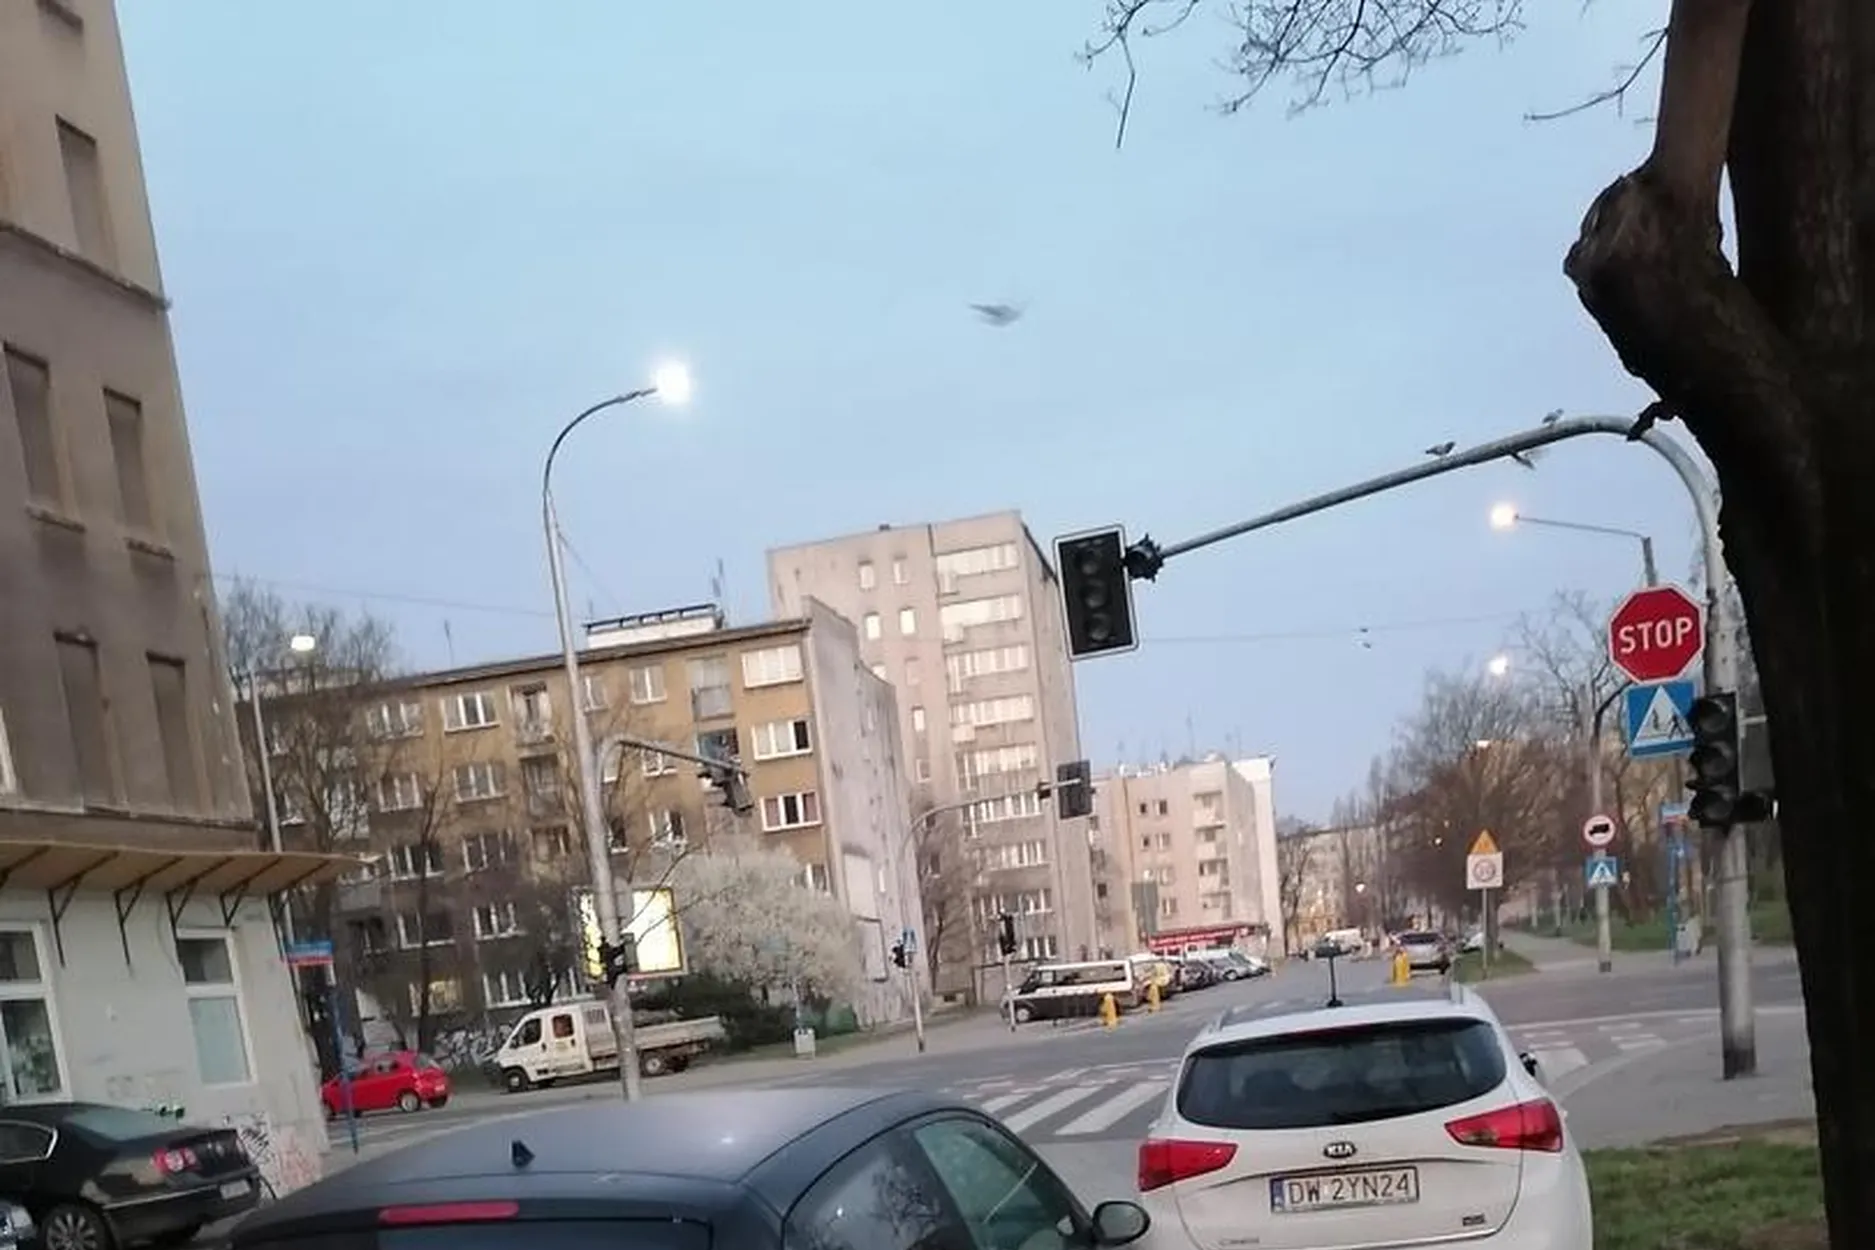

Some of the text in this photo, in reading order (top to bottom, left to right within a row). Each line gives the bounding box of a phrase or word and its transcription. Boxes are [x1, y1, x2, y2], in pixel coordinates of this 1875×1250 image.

[1618, 616, 1693, 654] STOP
[1327, 1143, 1354, 1156] KIA
[1288, 1173, 1410, 1205] DW 2YN24
